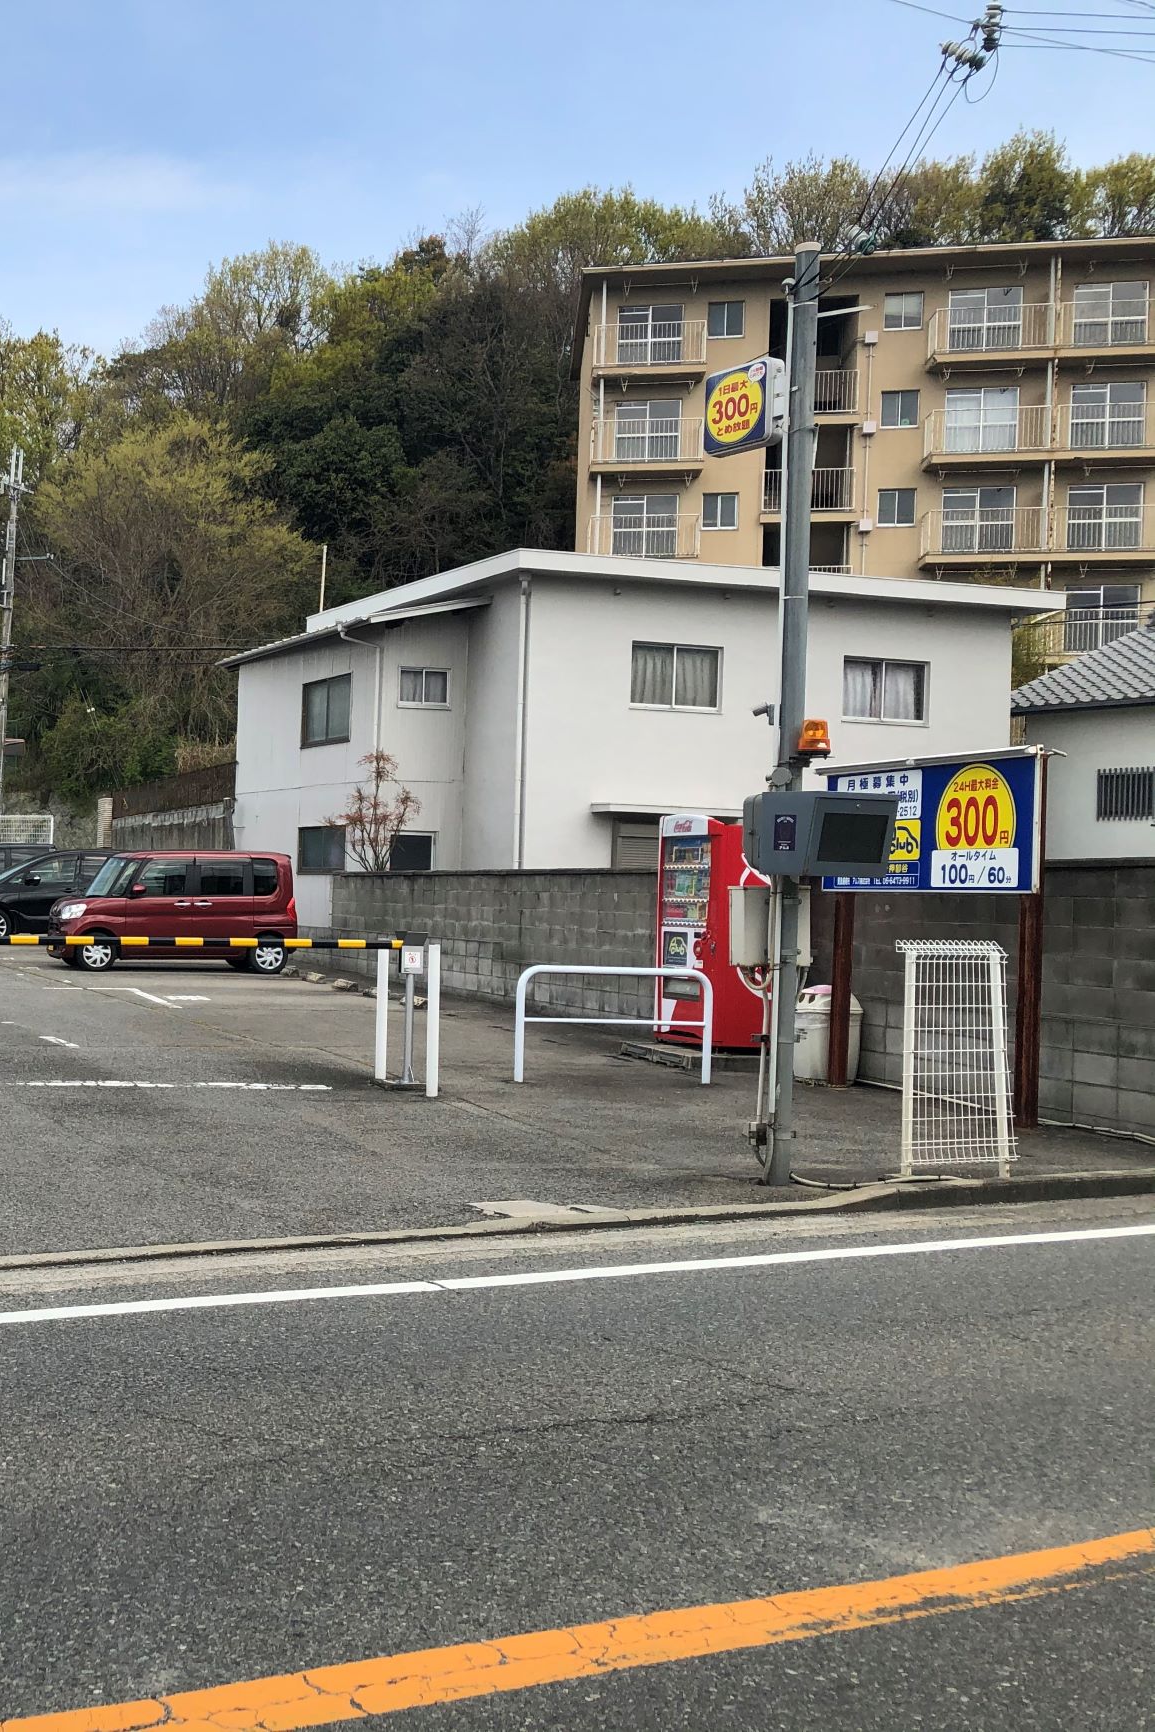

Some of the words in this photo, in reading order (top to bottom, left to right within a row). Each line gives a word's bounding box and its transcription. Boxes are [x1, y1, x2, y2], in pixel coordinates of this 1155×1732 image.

[718, 380, 748, 396] 1日最大
[712, 393, 758, 425] 300円
[717, 419, 750, 436] とめ放題
[847, 773, 909, 792] 月極募集中
[953, 777, 999, 793] 24H最大料金
[945, 795, 1009, 847] 300円
[951, 850, 996, 861] オールタイム
